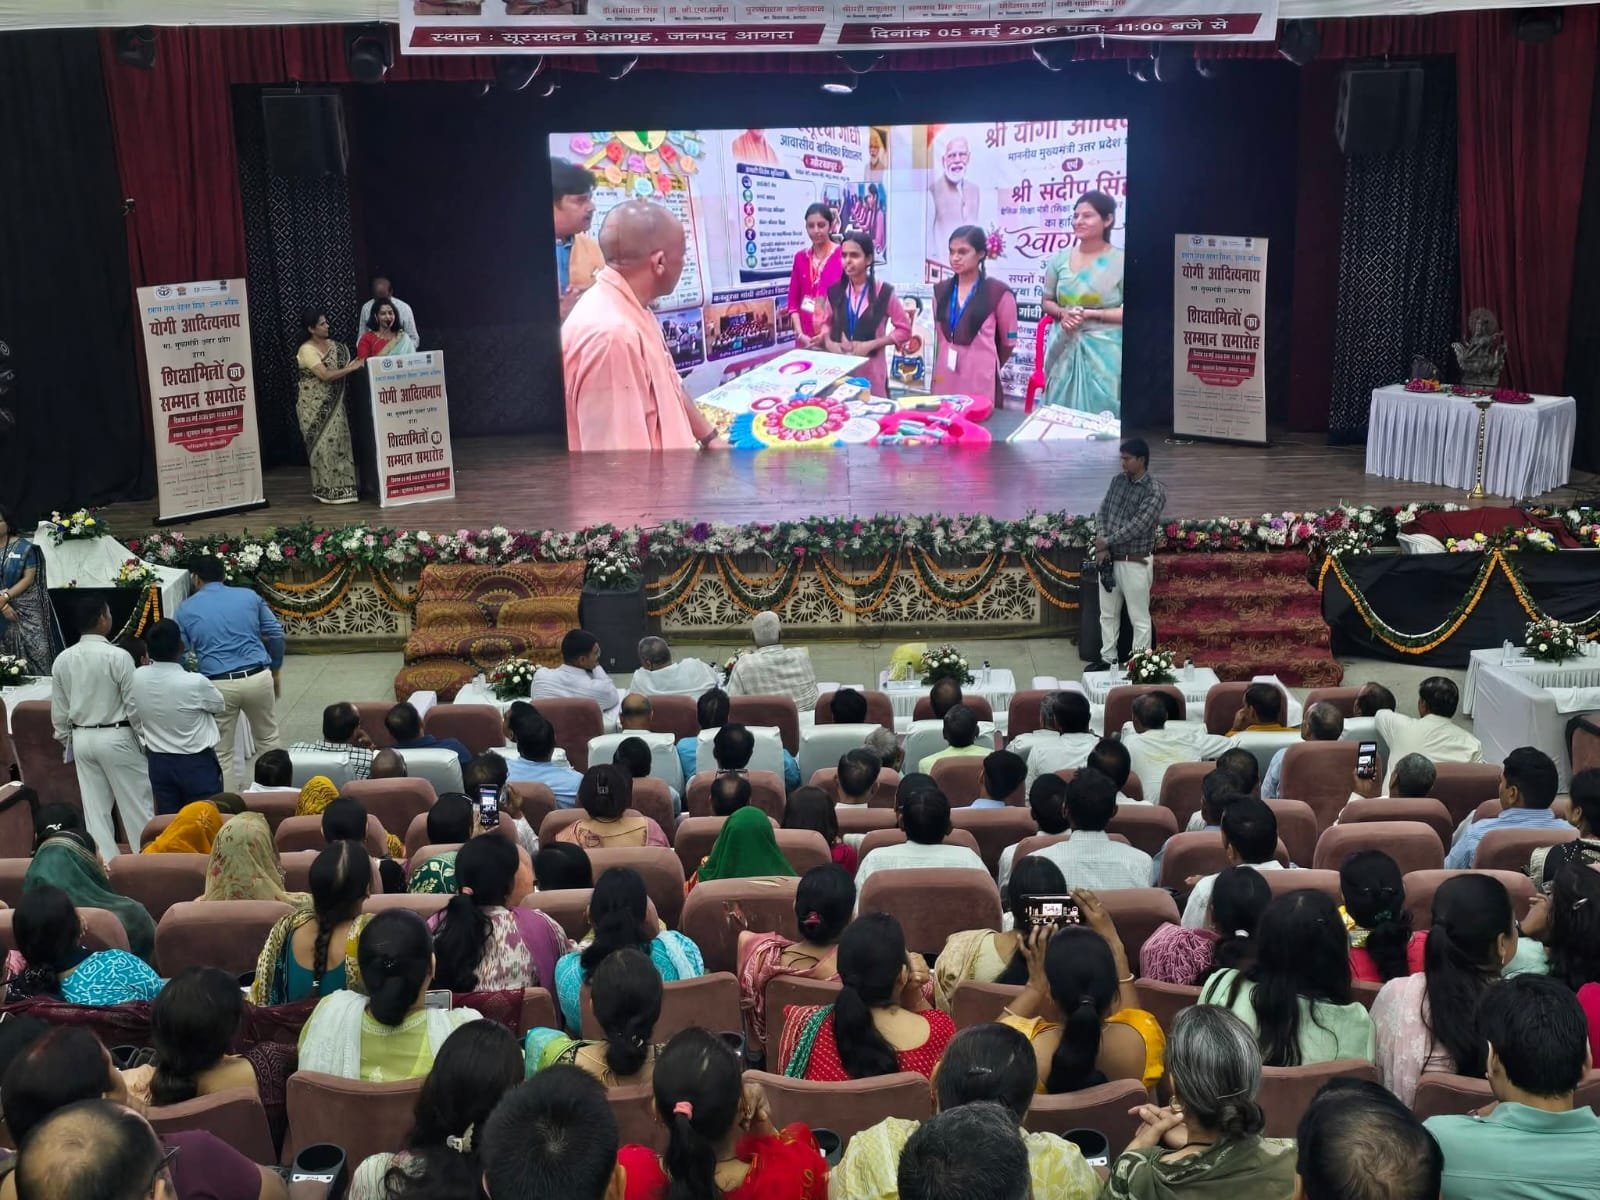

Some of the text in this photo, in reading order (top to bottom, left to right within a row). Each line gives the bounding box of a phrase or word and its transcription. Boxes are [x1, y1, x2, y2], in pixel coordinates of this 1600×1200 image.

[430, 32, 481, 43] स्थान
[502, 32, 578, 45] सूरसदन
[584, 29, 660, 44] प्रेक्षागृह,
[666, 31, 729, 41] जनपद
[735, 30, 795, 40] आगरा
[869, 26, 931, 38] दिनांक
[937, 28, 963, 37] 05
[968, 23, 1001, 38] मई
[1008, 25, 1058, 35] 2026
[1115, 22, 1164, 32] 11:00
[1169, 18, 1204, 31] बजे
[1209, 17, 1229, 30] से
[779, 134, 815, 152] आवासीय
[1008, 149, 1037, 161] माननीय
[1039, 141, 1076, 160] मुख्यमंत्री
[1098, 136, 1121, 150] प्रदेश
[1012, 178, 1033, 203] श्री
[1039, 174, 1091, 201] संदीप
[1044, 218, 1056, 228] का
[1014, 231, 1079, 259] स्वाग
[1008, 272, 1035, 285] सपनों
[1181, 262, 1205, 280] योगी
[1018, 305, 1042, 319] गांधी
[149, 316, 177, 336] योगी
[1182, 330, 1261, 350] सम्मान समारोह
[159, 383, 247, 413] सम्मान समारोह
[378, 386, 398, 405] योगी
